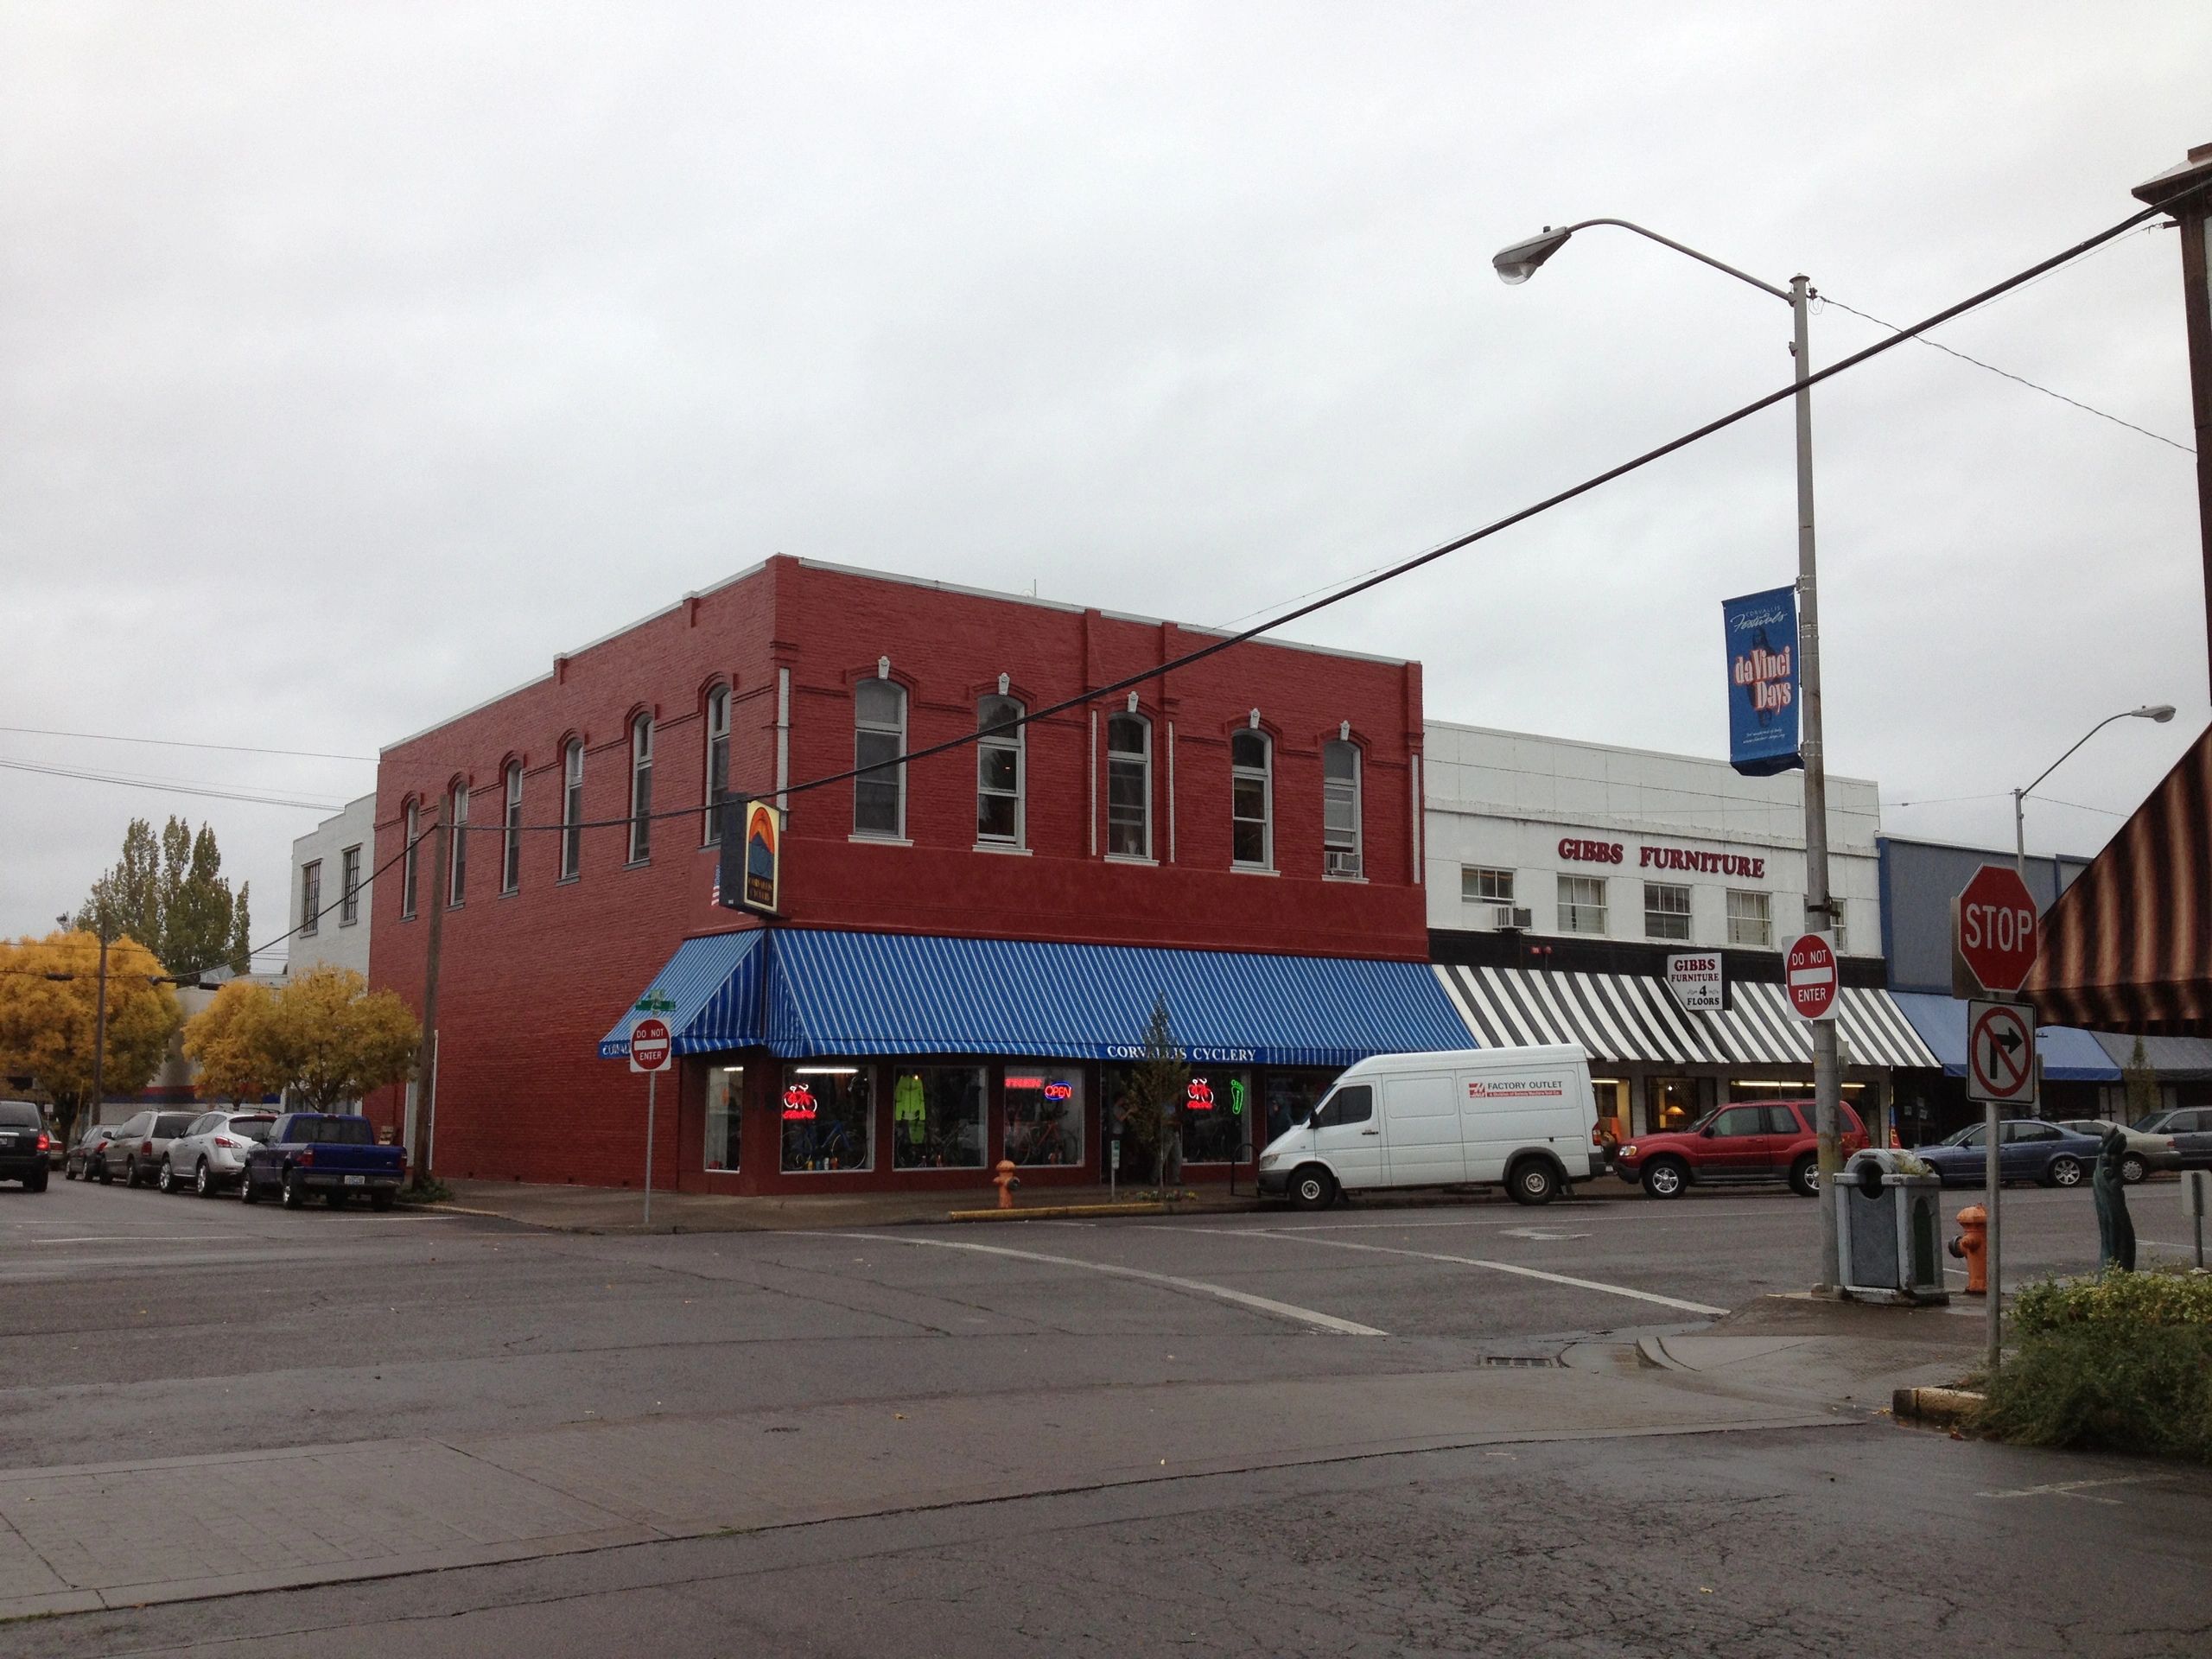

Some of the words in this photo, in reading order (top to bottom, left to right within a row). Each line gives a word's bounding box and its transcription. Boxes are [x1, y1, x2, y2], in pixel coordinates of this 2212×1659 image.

[1730, 611, 1788, 632] Festivals
[1755, 682, 1792, 714] Days
[1558, 838, 1624, 865] GIBBS
[1640, 846, 1764, 878] FURNITURE
[1965, 903, 2032, 952] STOP
[1674, 958, 1716, 972] GIBBS
[1792, 952, 1804, 966] DO
[1810, 950, 1827, 963] NOT
[1671, 973, 1719, 982] FURNITURE
[1699, 985, 1707, 996] 4
[1798, 988, 1826, 1002] ENTER
[1687, 997, 1719, 1006] FLOORS
[636, 1030, 646, 1039] DO
[651, 1028, 664, 1037] NOT
[639, 1051, 662, 1061] ENTER
[1192, 1047, 1256, 1062] CYCLERY
[1045, 1085, 1071, 1098] OPEN
[1488, 1082, 1526, 1090] FACTORY
[1529, 1080, 1562, 1089] OUTLET
